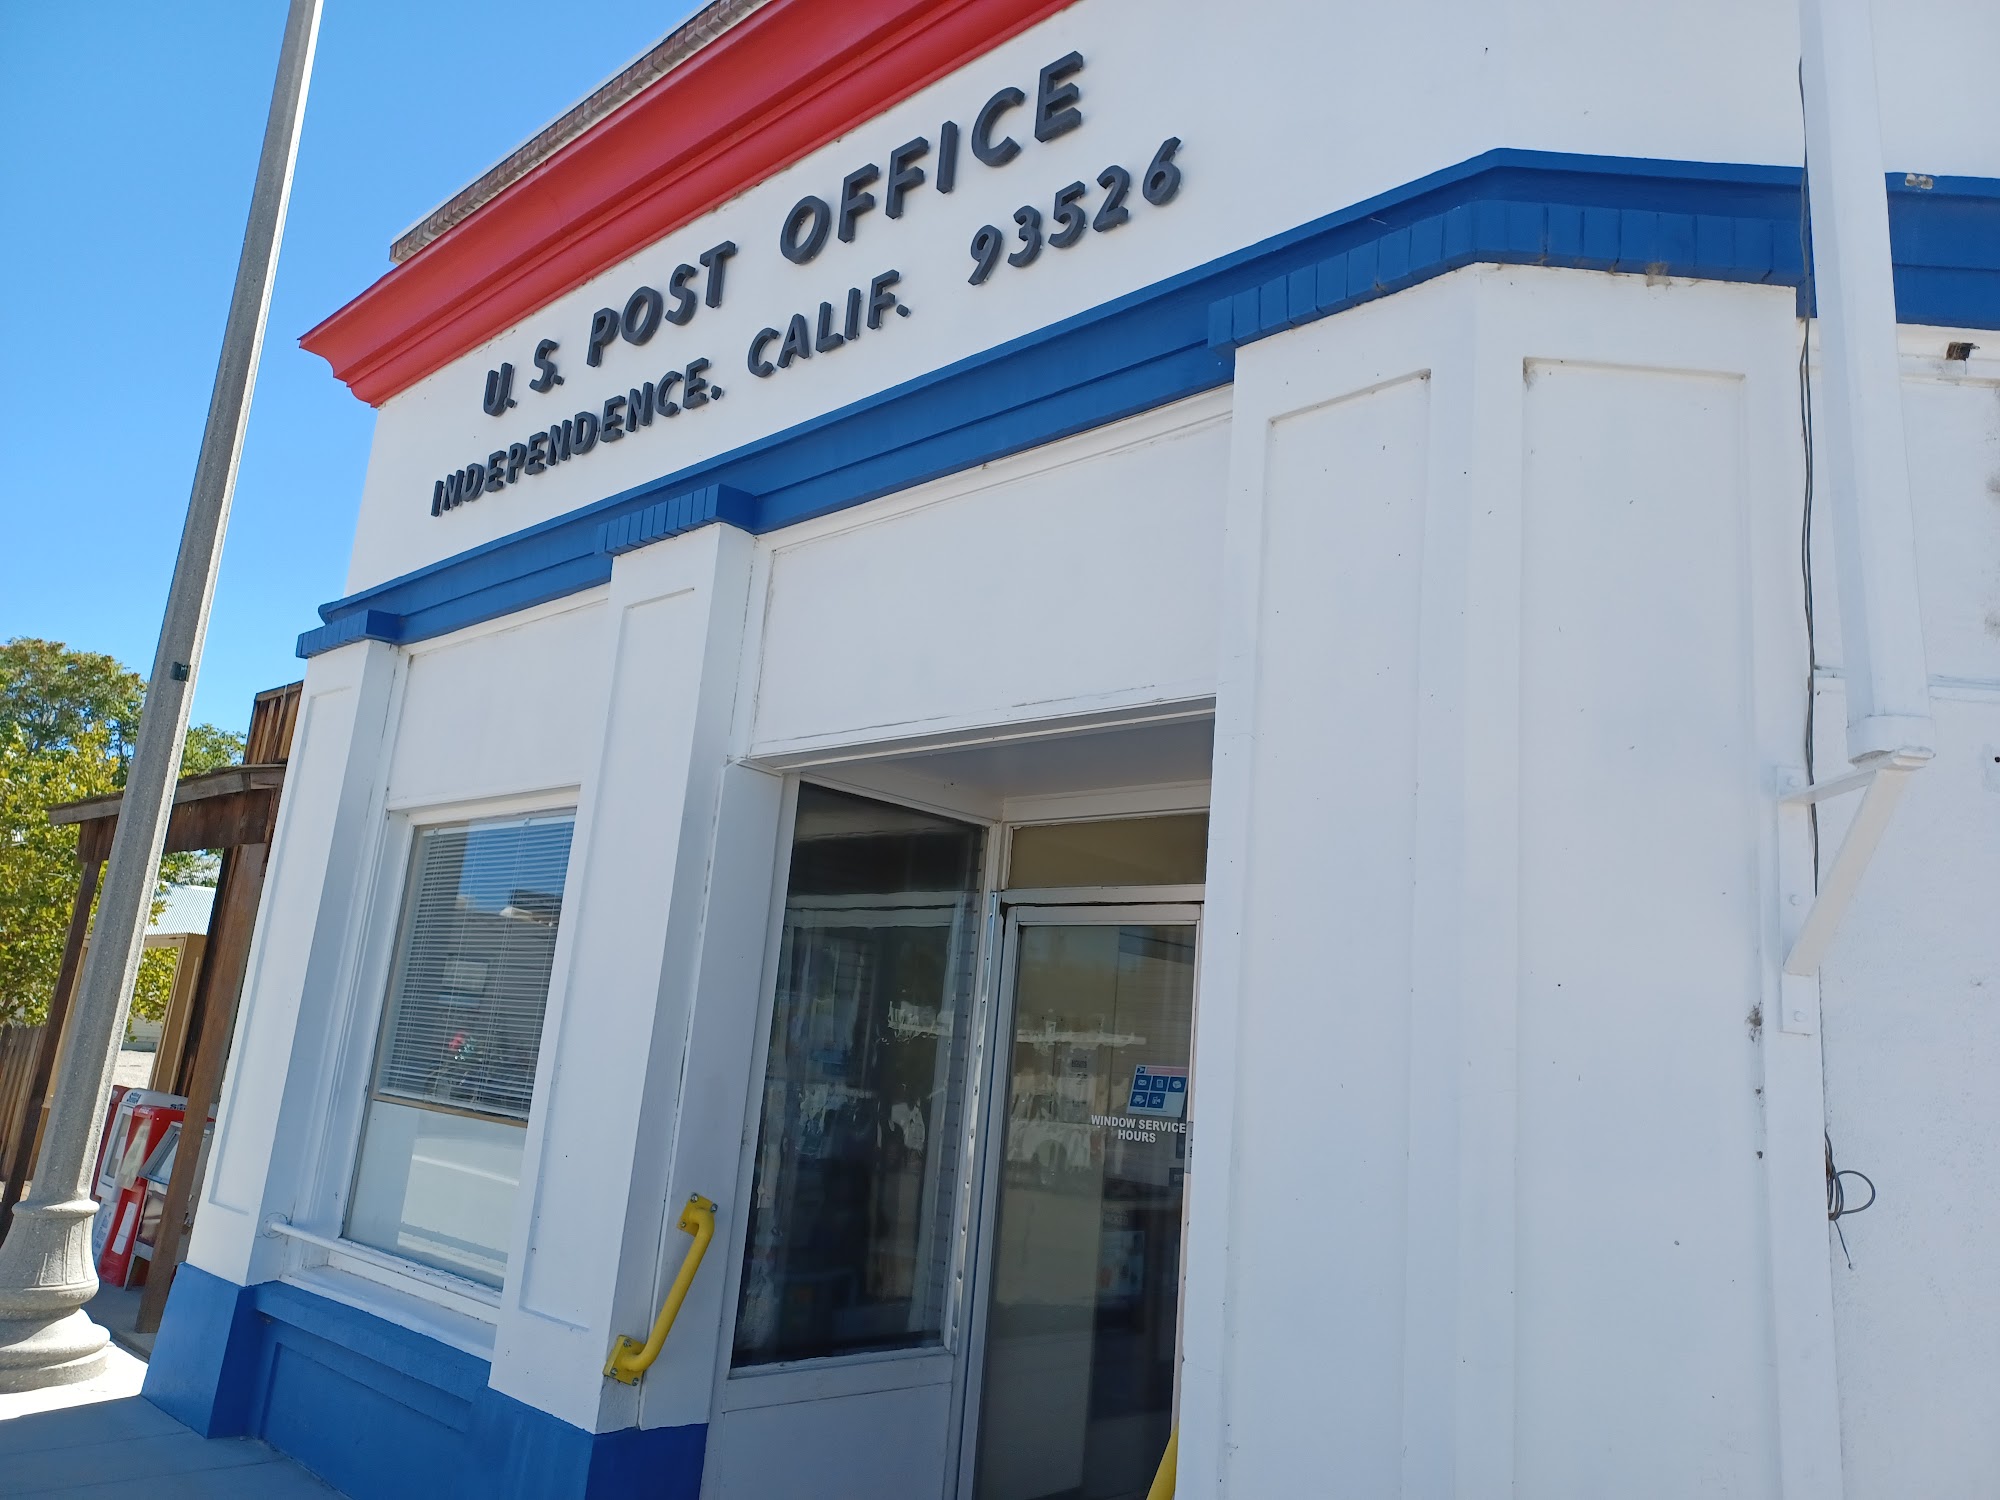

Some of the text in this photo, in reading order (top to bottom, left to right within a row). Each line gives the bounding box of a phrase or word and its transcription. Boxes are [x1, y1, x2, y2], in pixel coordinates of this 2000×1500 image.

[483, 50, 1085, 418] U. S. POST OFFICE
[747, 269, 912, 379] CALIF.
[967, 136, 1183, 287] 93526
[1091, 1114, 1186, 1134] WINDOW SERVICE
[1117, 1129, 1156, 1143] HOURS
